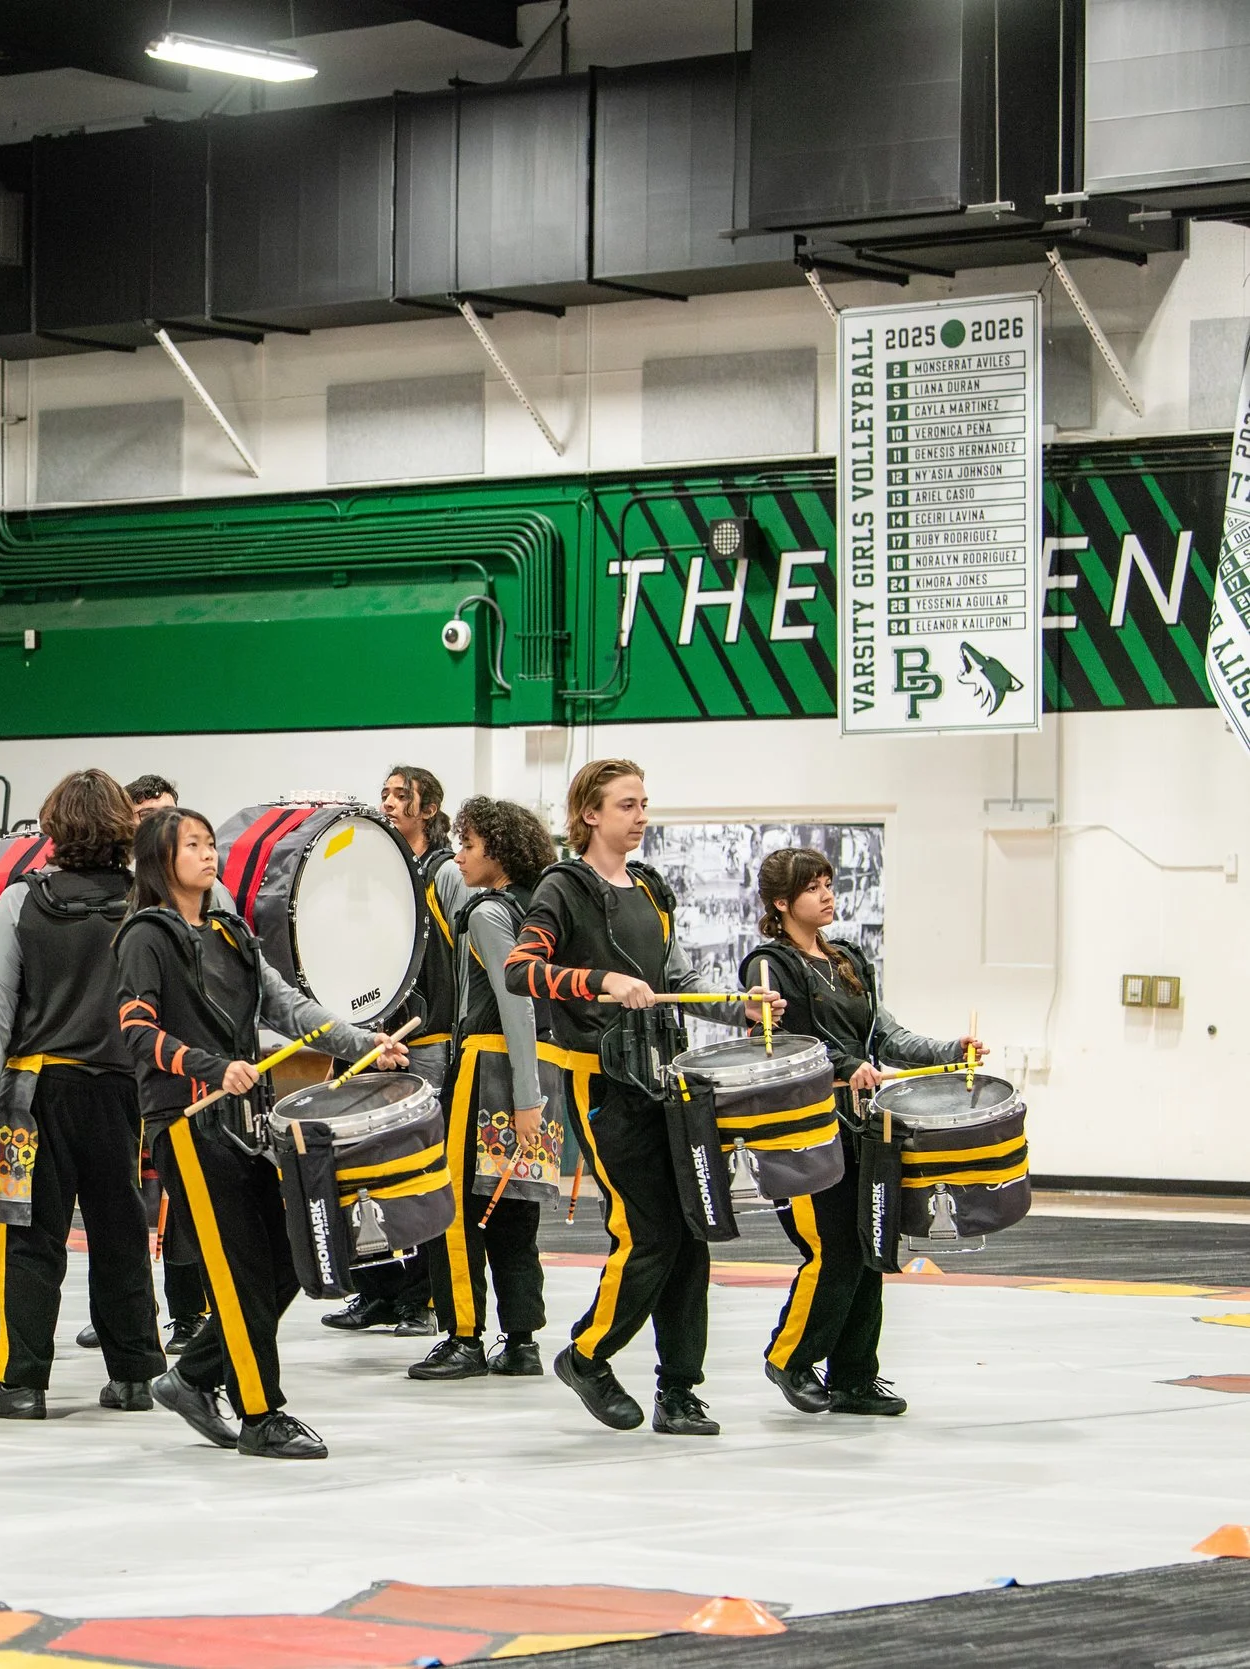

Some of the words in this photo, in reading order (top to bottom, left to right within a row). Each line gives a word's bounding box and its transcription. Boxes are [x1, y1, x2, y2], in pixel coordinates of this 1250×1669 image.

[886, 326, 936, 350] 2025
[972, 317, 1024, 343] 2026
[893, 364, 901, 377] 2
[915, 358, 972, 374] MONSERRAT
[976, 355, 1011, 369] AVILES
[893, 386, 901, 398] 5
[915, 383, 944, 396] LIANA
[948, 379, 980, 393] DURAN
[852, 328, 874, 502] VOLLEYBALL
[893, 407, 901, 420] 7
[915, 404, 946, 417] CAYLA
[950, 399, 999, 414] MARTINEZ
[891, 429, 903, 442] 10
[915, 425, 963, 439] VERONICA
[966, 420, 992, 434] PEÑA
[893, 450, 902, 463] 11
[915, 446, 955, 460] GENESIS
[959, 441, 1017, 457] HERNANDEZ
[891, 471, 903, 484] 12
[958, 464, 1003, 478] JOHNSON
[891, 493, 903, 505] 13
[915, 490, 943, 503] ARIEL
[946, 488, 975, 501] CASIO
[891, 514, 903, 527] 14
[915, 512, 946, 525] ECEIRI
[949, 509, 985, 522] LAVINA
[892, 535, 903, 548] 17
[916, 533, 940, 546] RUBY
[943, 529, 998, 544] RODRIGUEZ
[852, 511, 875, 588] GIRLS
[892, 557, 904, 570] 18
[916, 554, 959, 567] NORALYN
[963, 550, 1018, 565] RODRIGUEZ
[1221, 560, 1234, 576] 15
[607, 549, 828, 647] THE
[1042, 531, 1192, 630] EN
[890, 578, 906, 592] 24
[916, 576, 952, 589] KIMORA
[956, 573, 988, 586] JONES
[1227, 576, 1241, 592] 17
[890, 600, 906, 613] 26
[916, 597, 962, 610] YESSENIA
[966, 594, 1008, 608] AGUILAR
[916, 619, 958, 632] ELEANOR
[962, 615, 1012, 629] KAILIPONI
[853, 599, 875, 715] VARSITY
[350, 987, 381, 1010] EVANS
[690, 1145, 717, 1226] PROMARK
[872, 1182, 883, 1258] PROMARK
[309, 1198, 334, 1285] PROMARK
